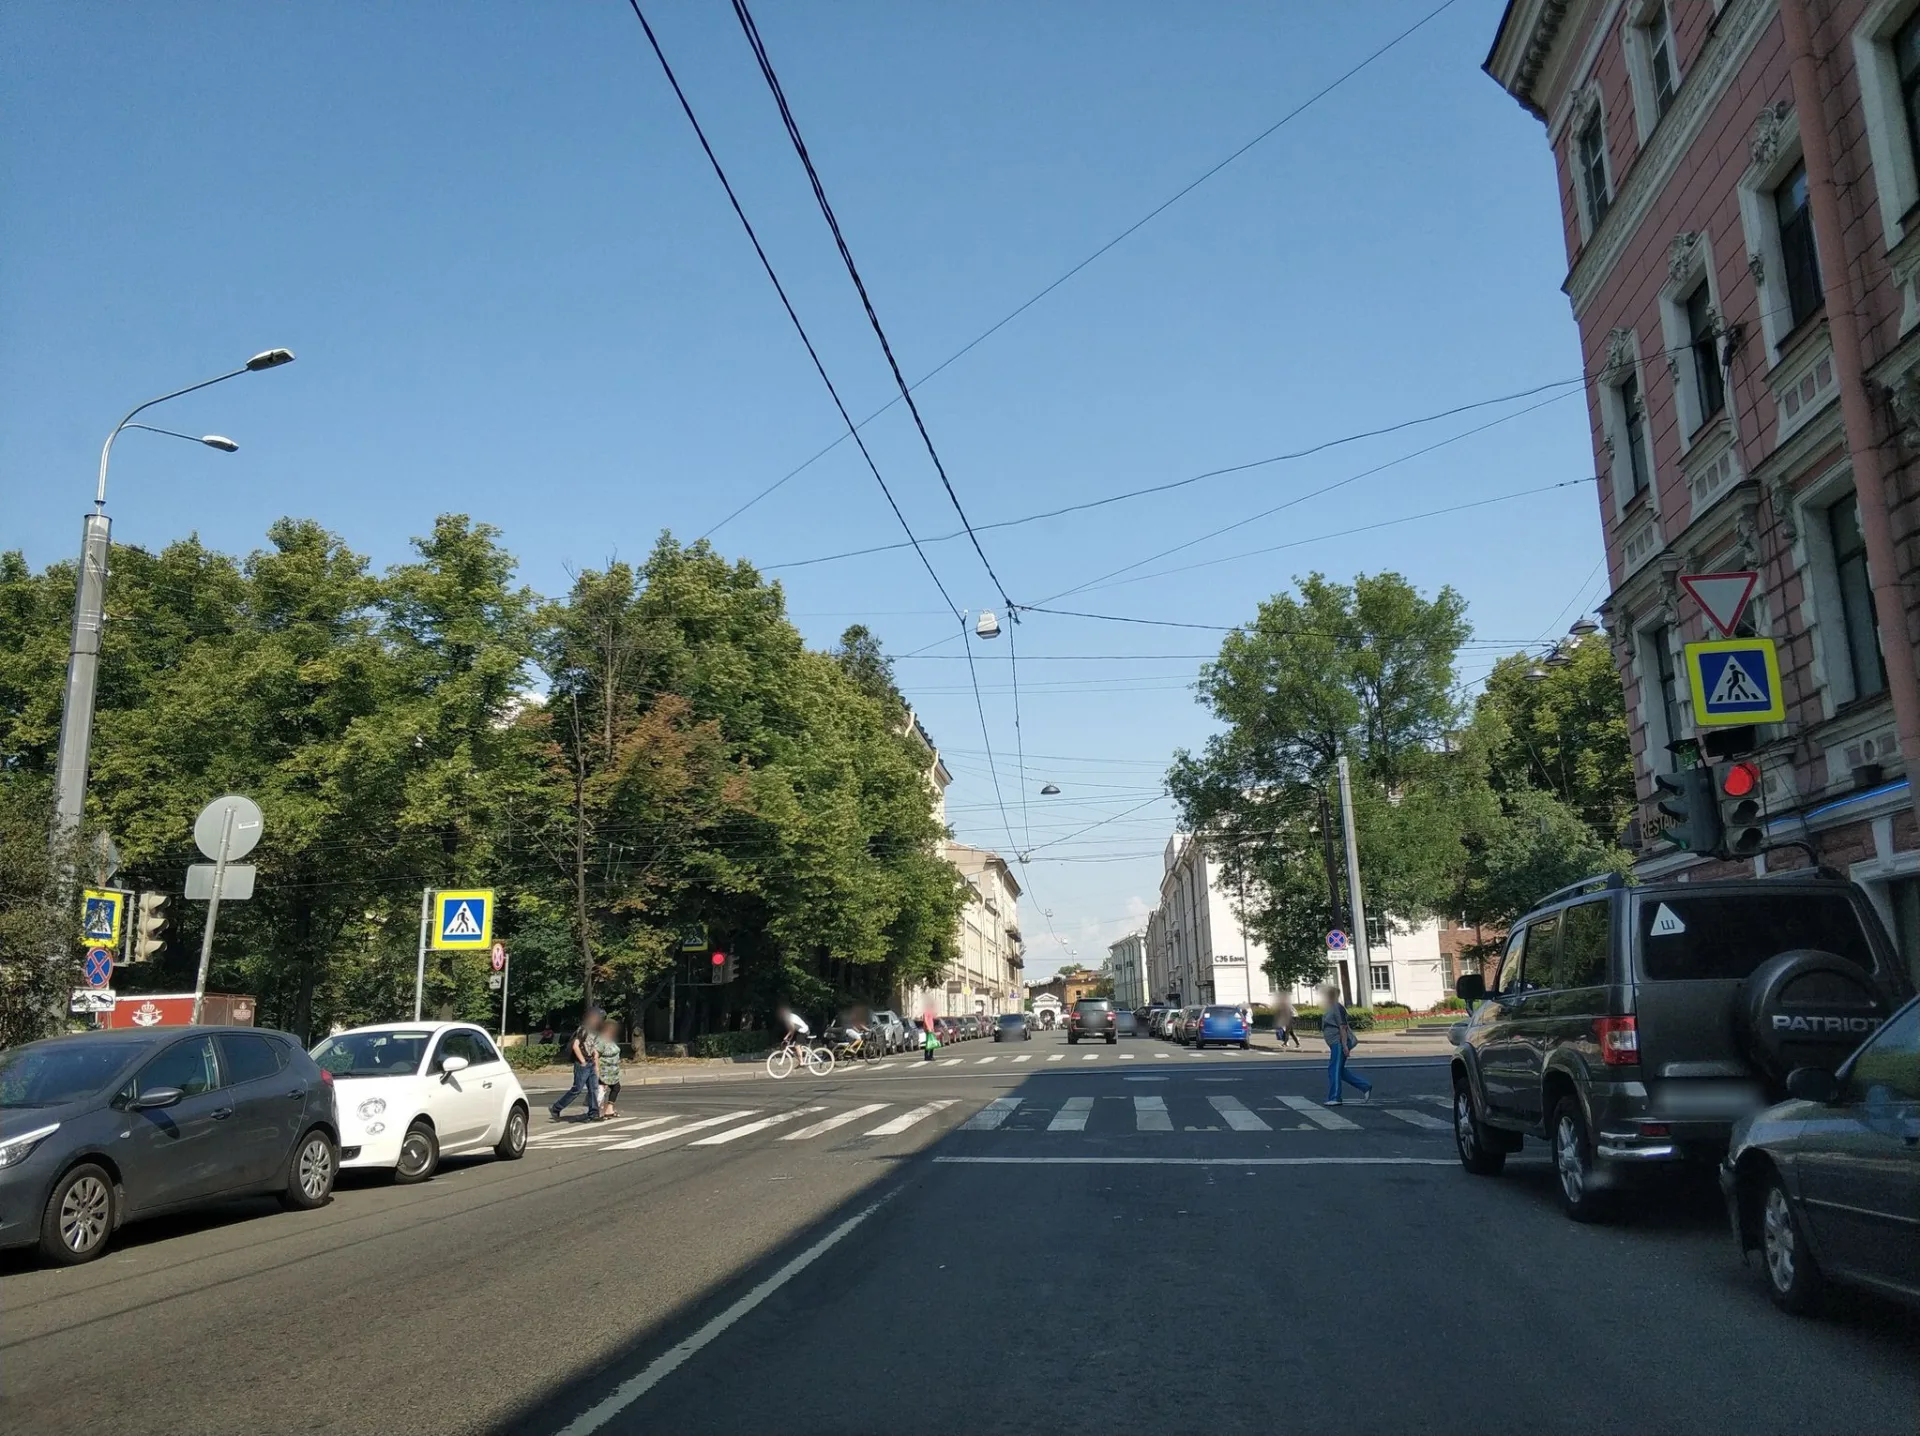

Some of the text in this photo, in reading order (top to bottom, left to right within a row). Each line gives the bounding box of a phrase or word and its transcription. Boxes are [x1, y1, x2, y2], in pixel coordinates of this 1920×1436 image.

[1641, 813, 1681, 839] RESTAU
[1214, 955, 1245, 963] СЭБ Банк
[1772, 1015, 1884, 1031] PATRIOT
